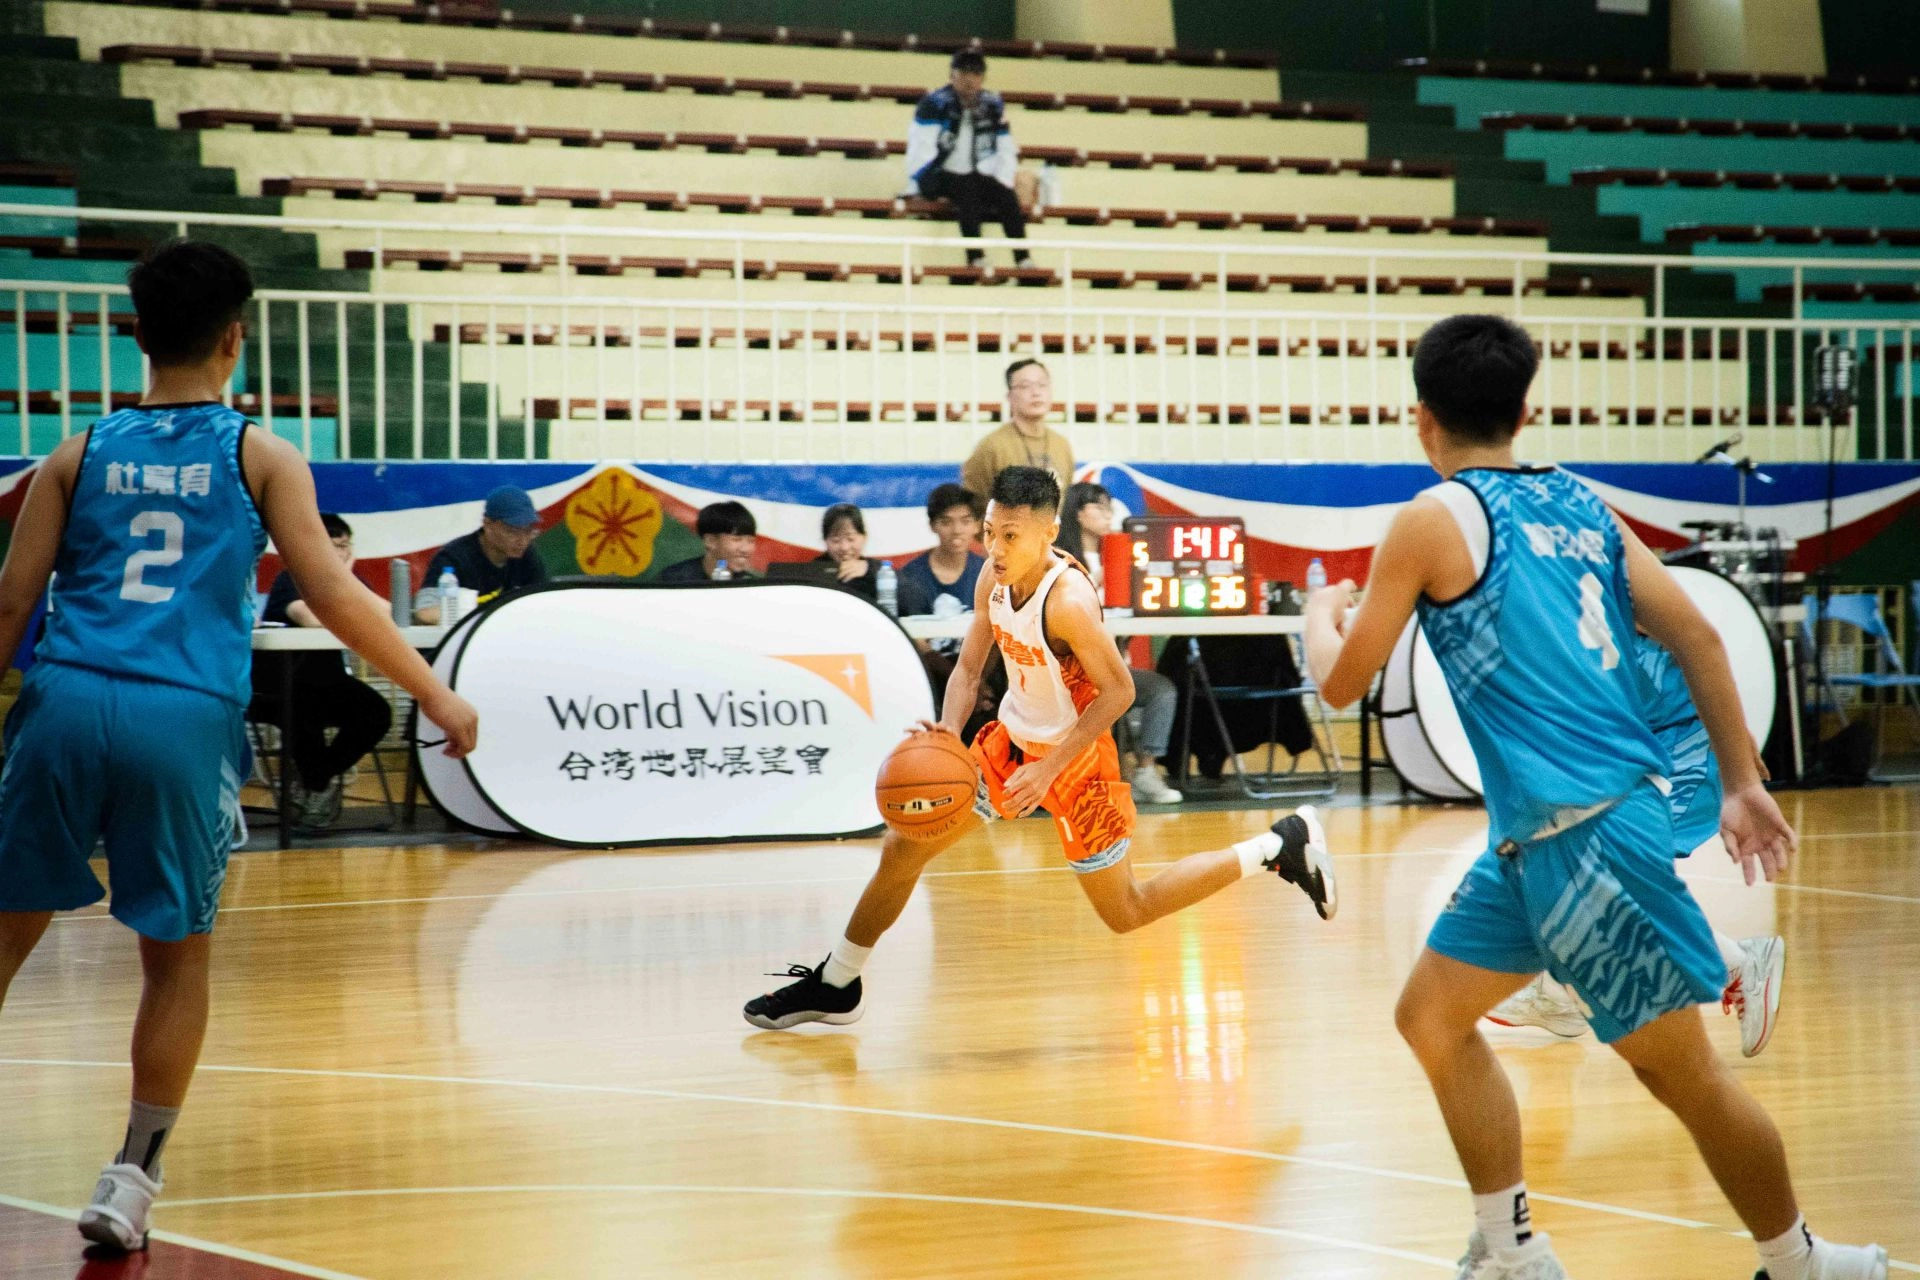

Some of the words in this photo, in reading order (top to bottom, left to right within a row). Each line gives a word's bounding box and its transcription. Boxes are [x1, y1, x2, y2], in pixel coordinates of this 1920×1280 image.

[119, 511, 185, 603] 2
[1142, 576, 1180, 610] 21
[1210, 575, 1246, 609] 36
[546, 688, 683, 730] World
[695, 689, 829, 727] Vision
[1060, 816, 1075, 842] 1
